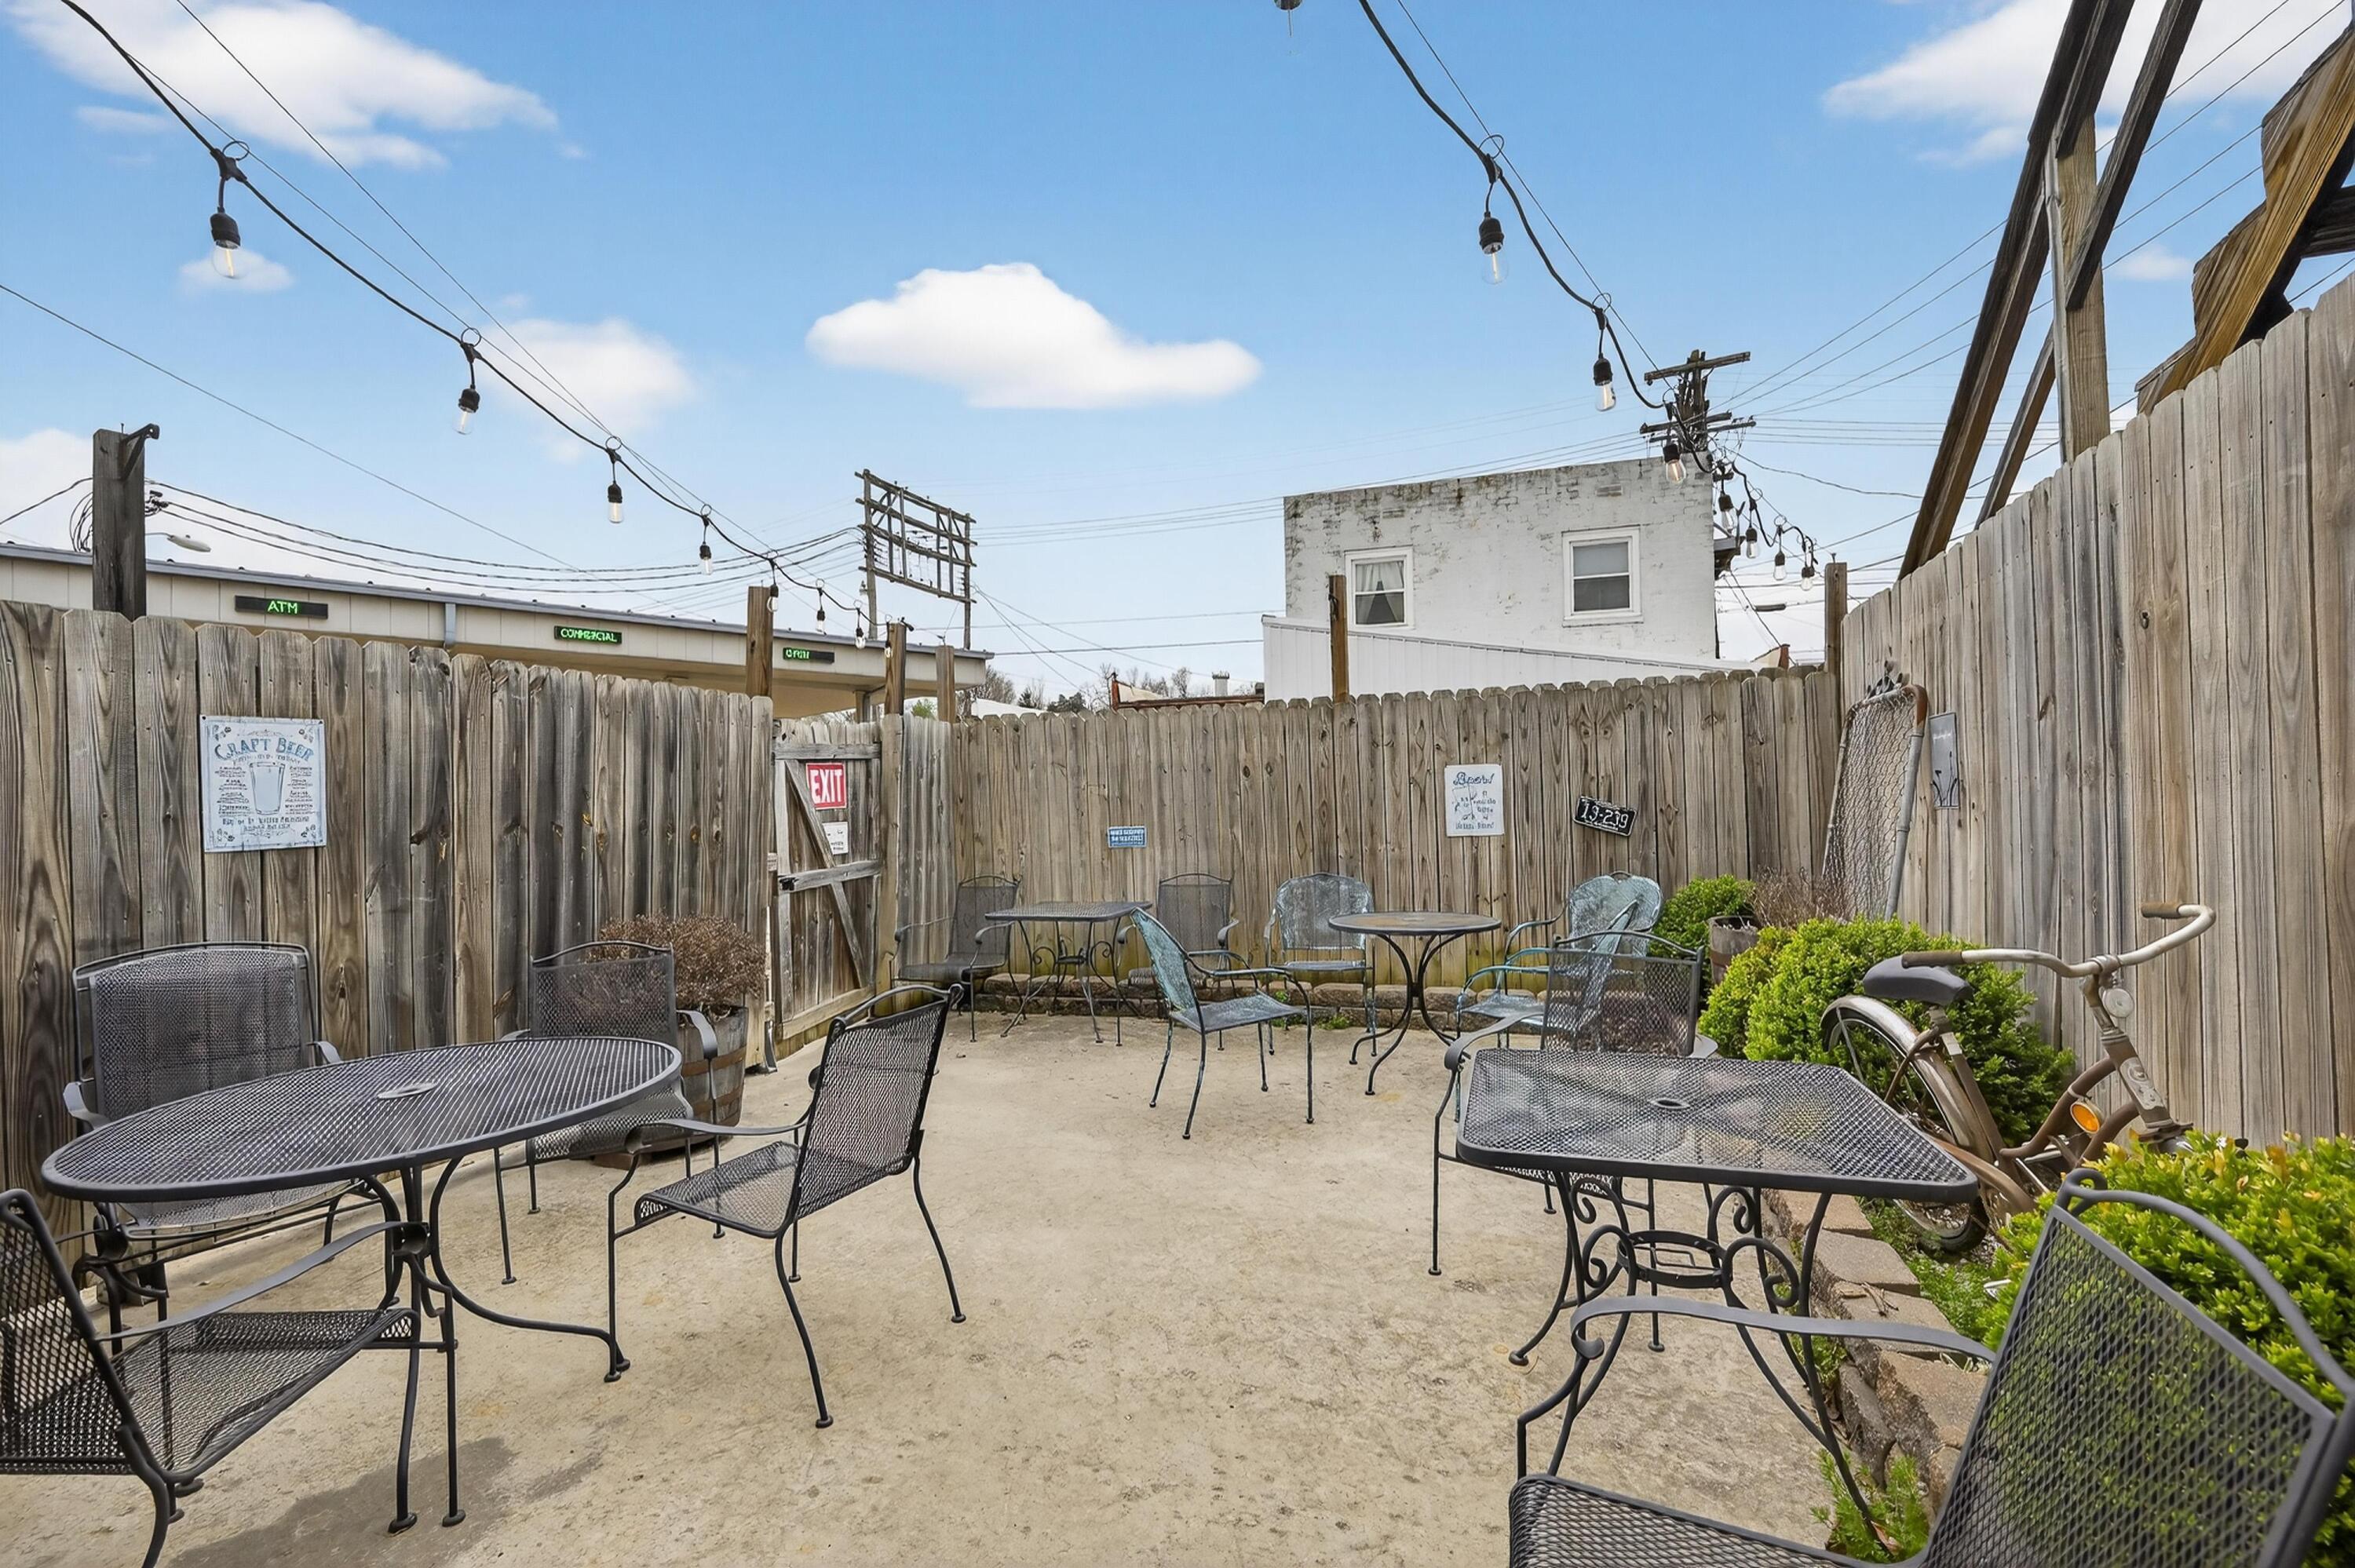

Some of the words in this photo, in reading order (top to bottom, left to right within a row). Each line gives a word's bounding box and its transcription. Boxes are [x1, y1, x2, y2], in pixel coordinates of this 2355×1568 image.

[268, 600, 298, 614] ATM
[214, 738, 271, 760] CRAFT
[276, 738, 314, 761] BEER
[809, 768, 842, 804] EXIT
